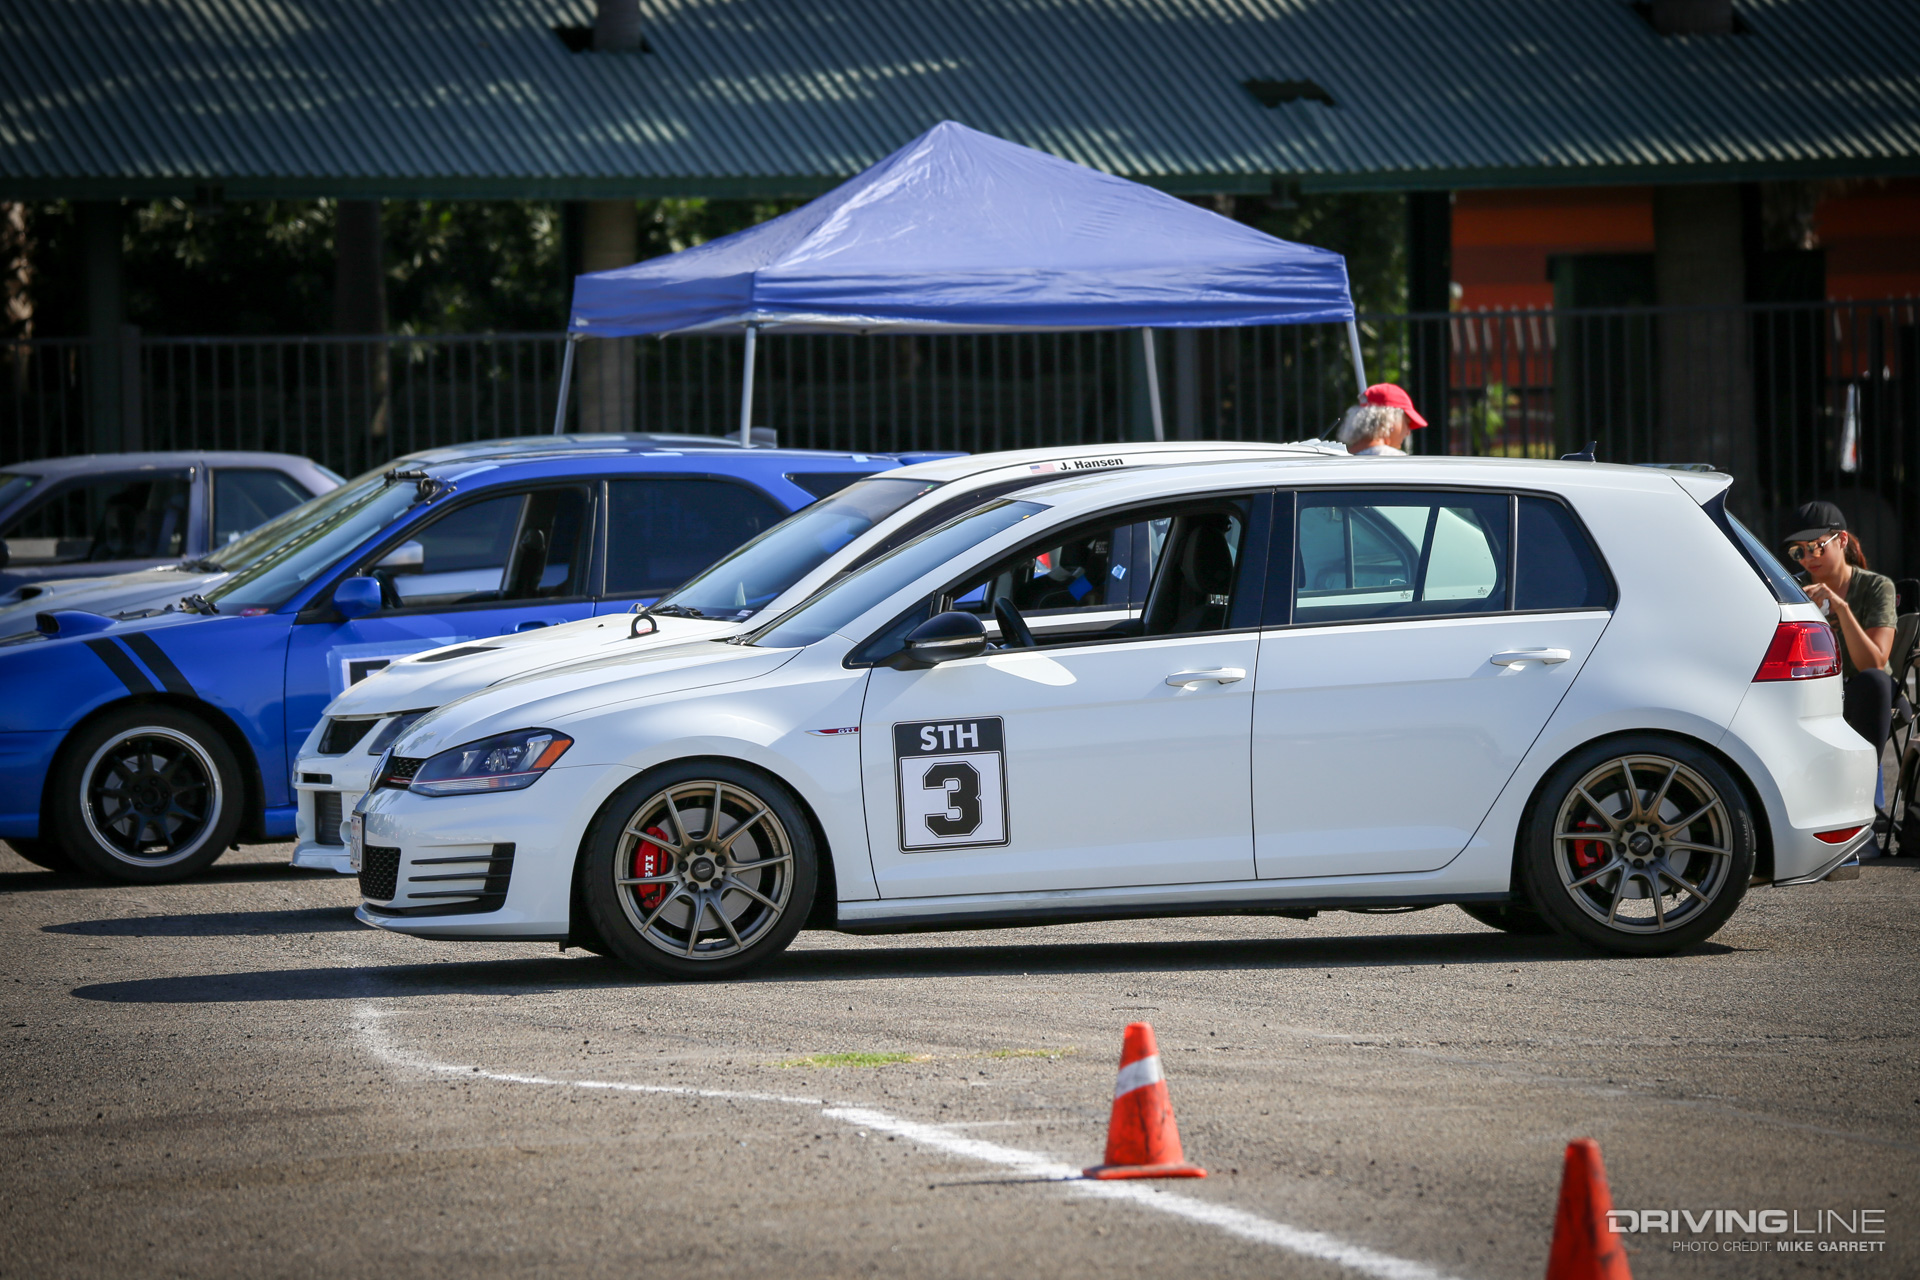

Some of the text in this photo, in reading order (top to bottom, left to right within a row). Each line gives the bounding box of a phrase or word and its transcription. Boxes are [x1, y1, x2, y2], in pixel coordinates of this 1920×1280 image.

[1060, 458, 1124, 471] J. Hansen
[920, 723, 979, 751] STH
[923, 761, 982, 838] 3
